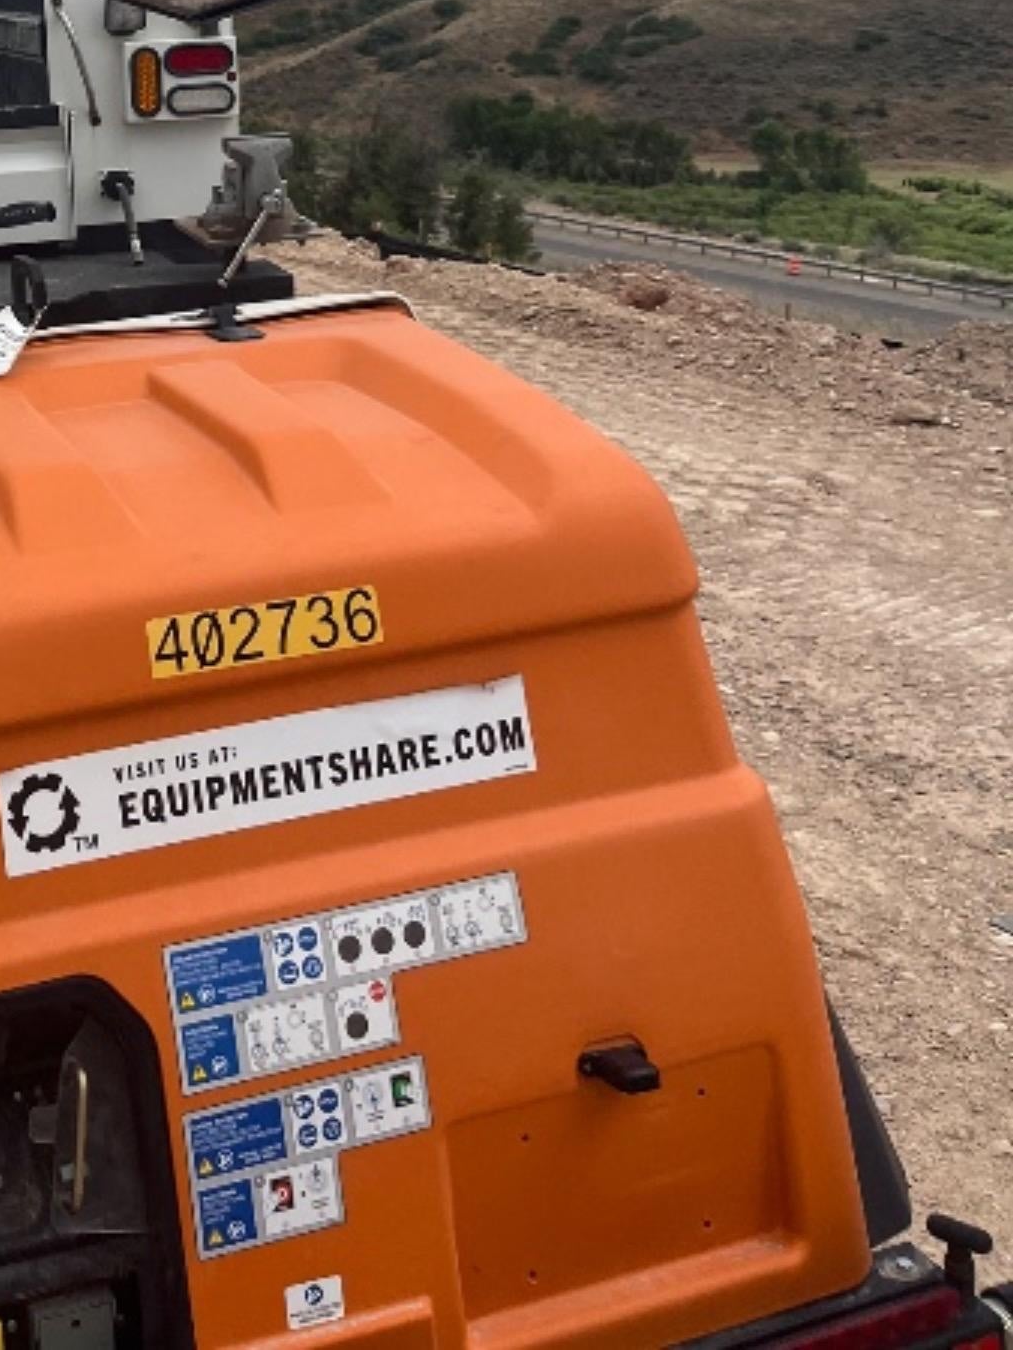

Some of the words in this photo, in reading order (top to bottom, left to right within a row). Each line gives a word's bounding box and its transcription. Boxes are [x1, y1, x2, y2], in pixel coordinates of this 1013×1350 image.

[154, 588, 378, 672] 402736
[112, 759, 166, 784] VISIT
[175, 752, 199, 772] US
[208, 746, 237, 766] AT:
[118, 716, 526, 828] EQUIPMENTSHARE.COM
